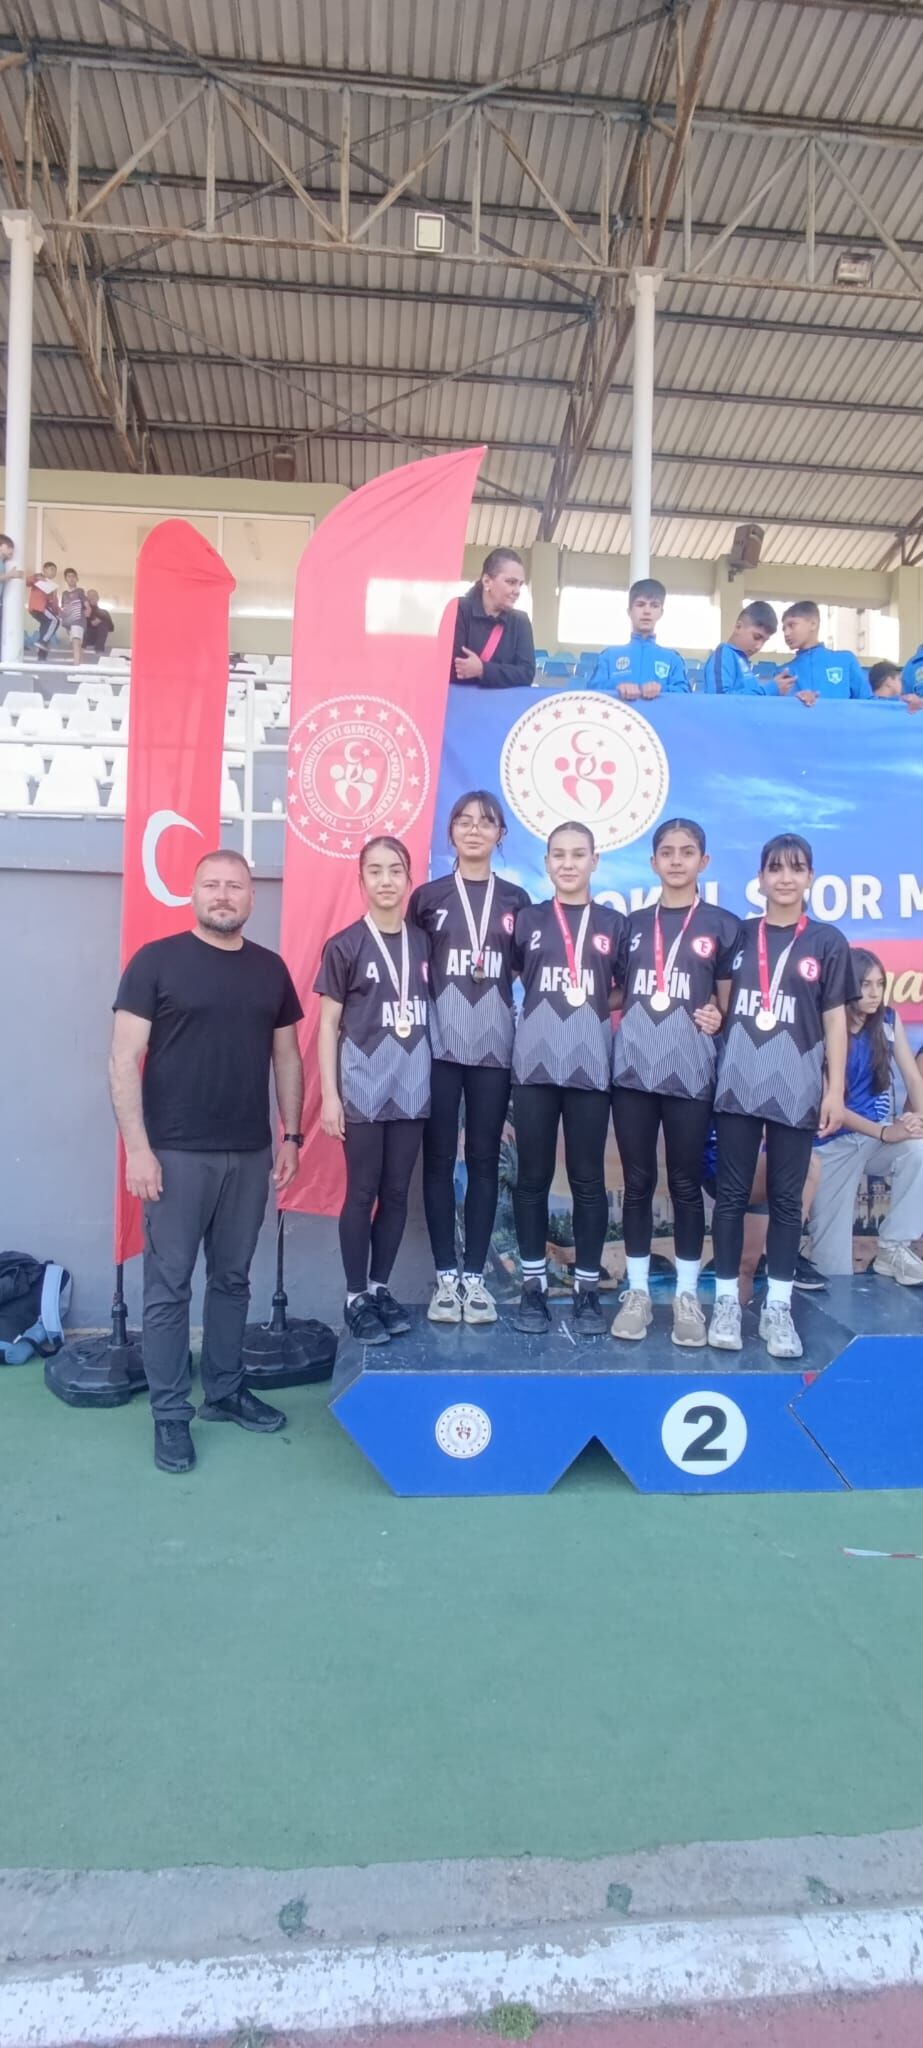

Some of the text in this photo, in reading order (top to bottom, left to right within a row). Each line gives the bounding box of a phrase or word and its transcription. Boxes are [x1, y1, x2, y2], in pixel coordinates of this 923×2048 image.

[343, 724, 387, 744] GENÇLİK
[745, 874, 884, 921] SOR
[435, 909, 448, 931] 7
[530, 930, 541, 951] 2
[629, 933, 642, 952] 5
[732, 949, 744, 970] 6
[366, 961, 381, 984] 4
[633, 967, 690, 1000] AFİN
[735, 988, 796, 1024] AFİN
[681, 1404, 728, 1462] 2
